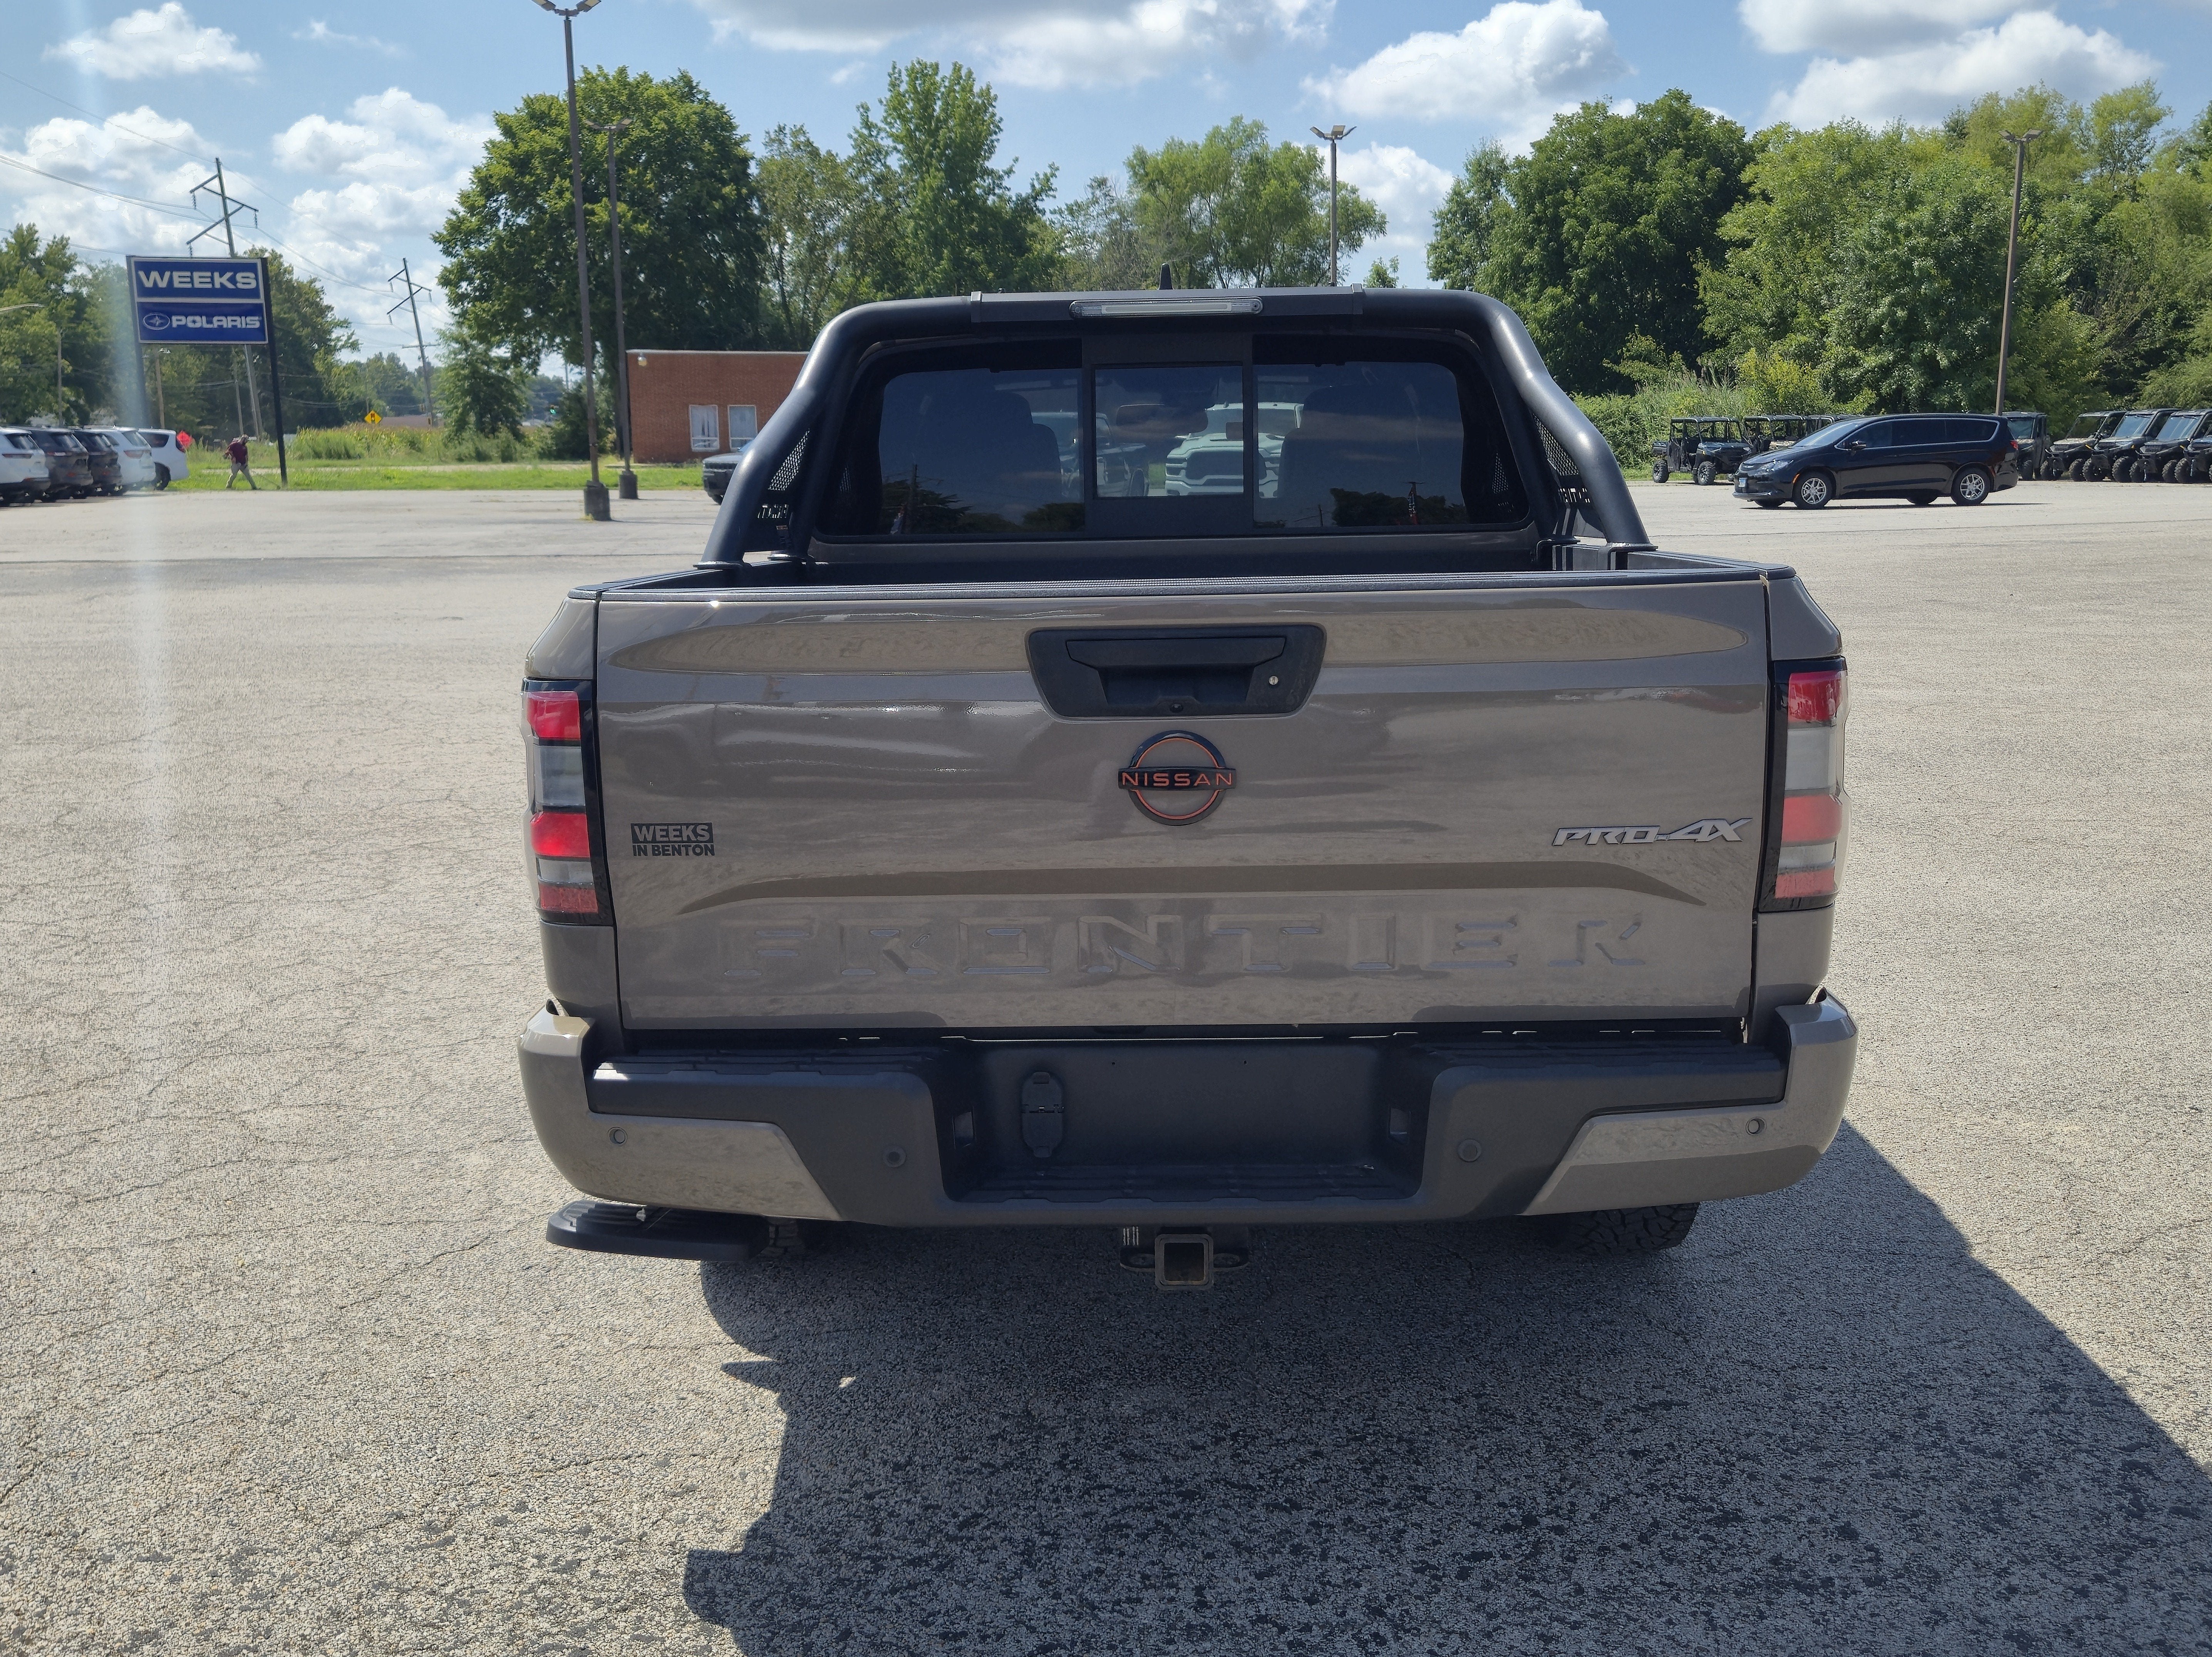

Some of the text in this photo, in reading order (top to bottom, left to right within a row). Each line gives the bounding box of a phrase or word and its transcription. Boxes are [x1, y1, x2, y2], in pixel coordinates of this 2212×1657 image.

[138, 270, 257, 289] WEEKS
[172, 315, 260, 328] POLARIS
[1122, 772, 1232, 787] NISSAN
[634, 825, 710, 841] WEEKS
[1552, 818, 1753, 846] PRO-4X
[632, 844, 715, 856] IN BENTON
[717, 912, 1646, 975] FRONTIER
